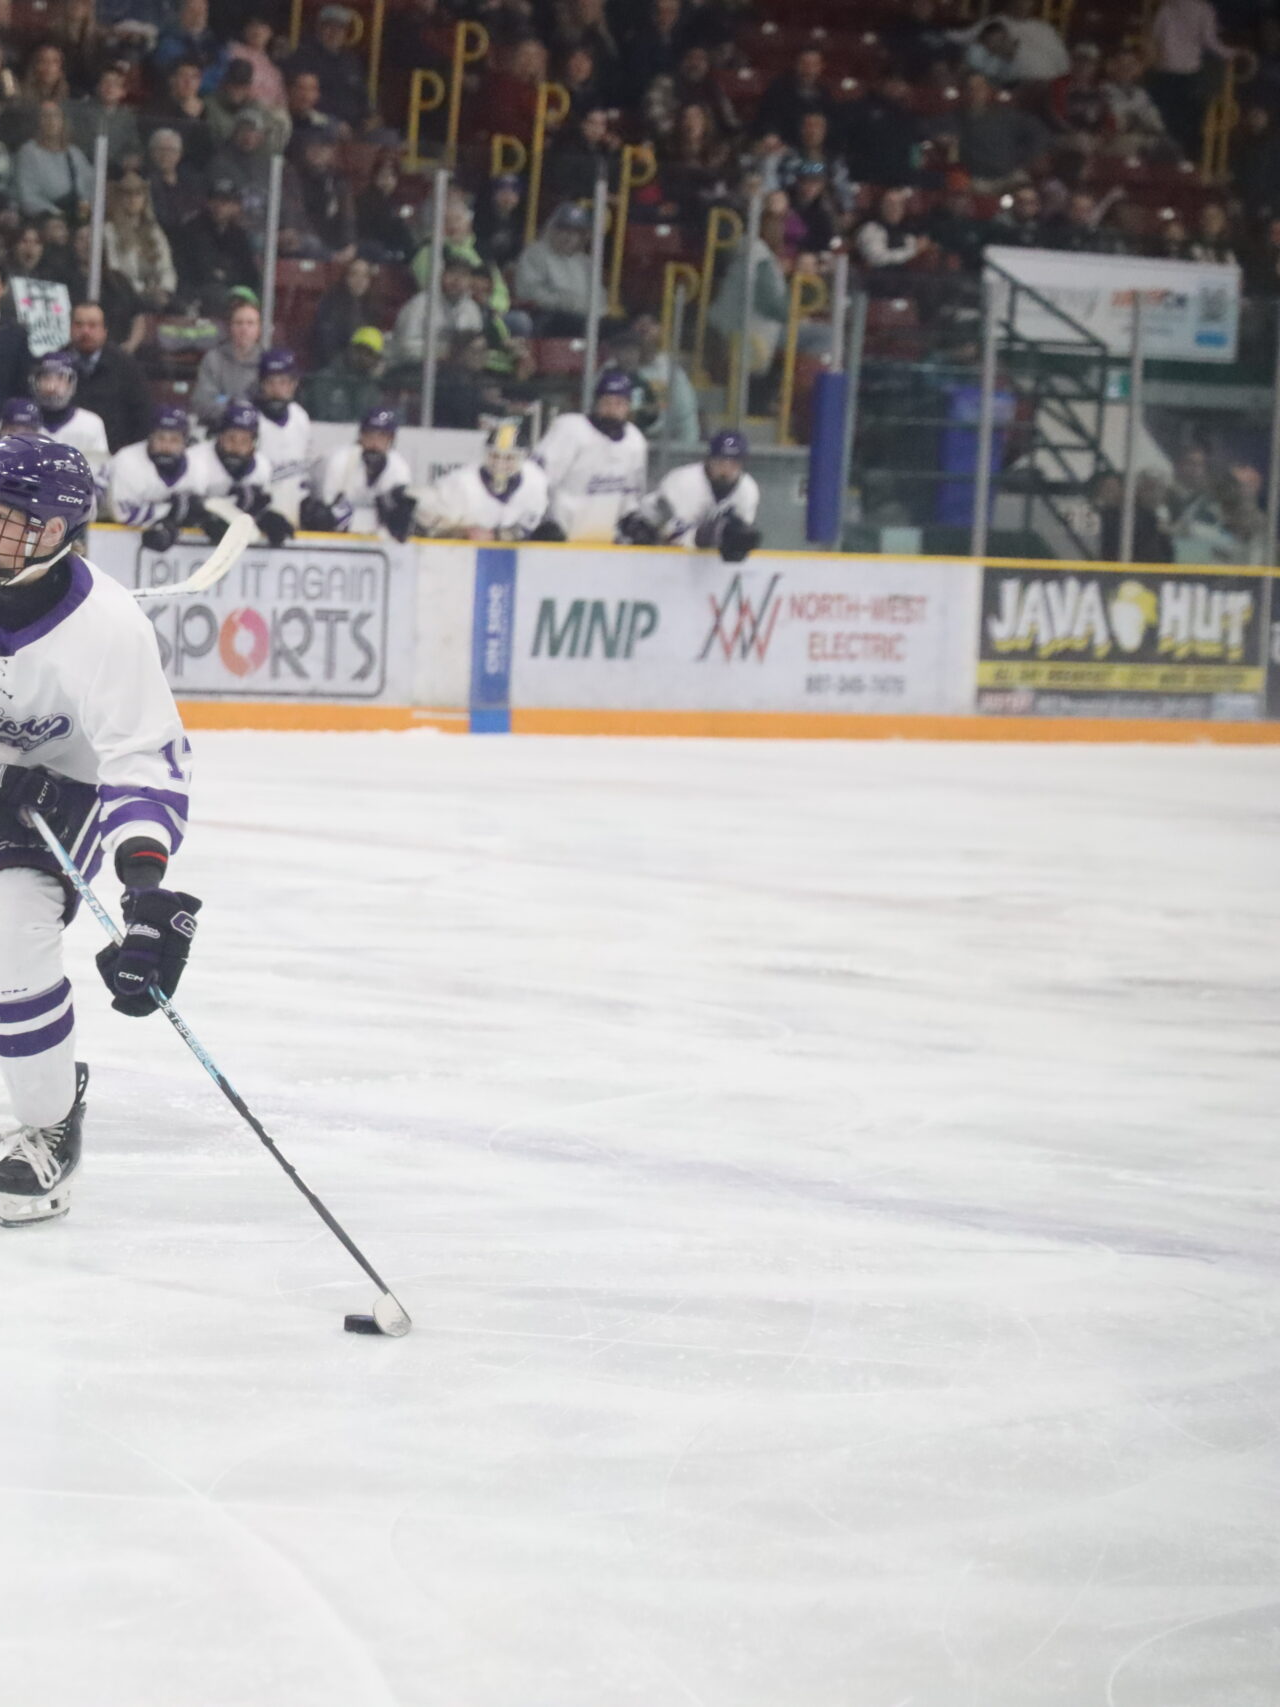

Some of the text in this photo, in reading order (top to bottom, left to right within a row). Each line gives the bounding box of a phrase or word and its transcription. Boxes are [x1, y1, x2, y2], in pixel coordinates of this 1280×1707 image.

[58, 494, 84, 505] CCM
[241, 561, 268, 598] IT
[531, 597, 660, 660] MNP
[988, 576, 1113, 657] JAVA
[1157, 580, 1254, 660] HUT
[807, 630, 907, 662] ELECTRIC
[118, 971, 144, 982] CCM
